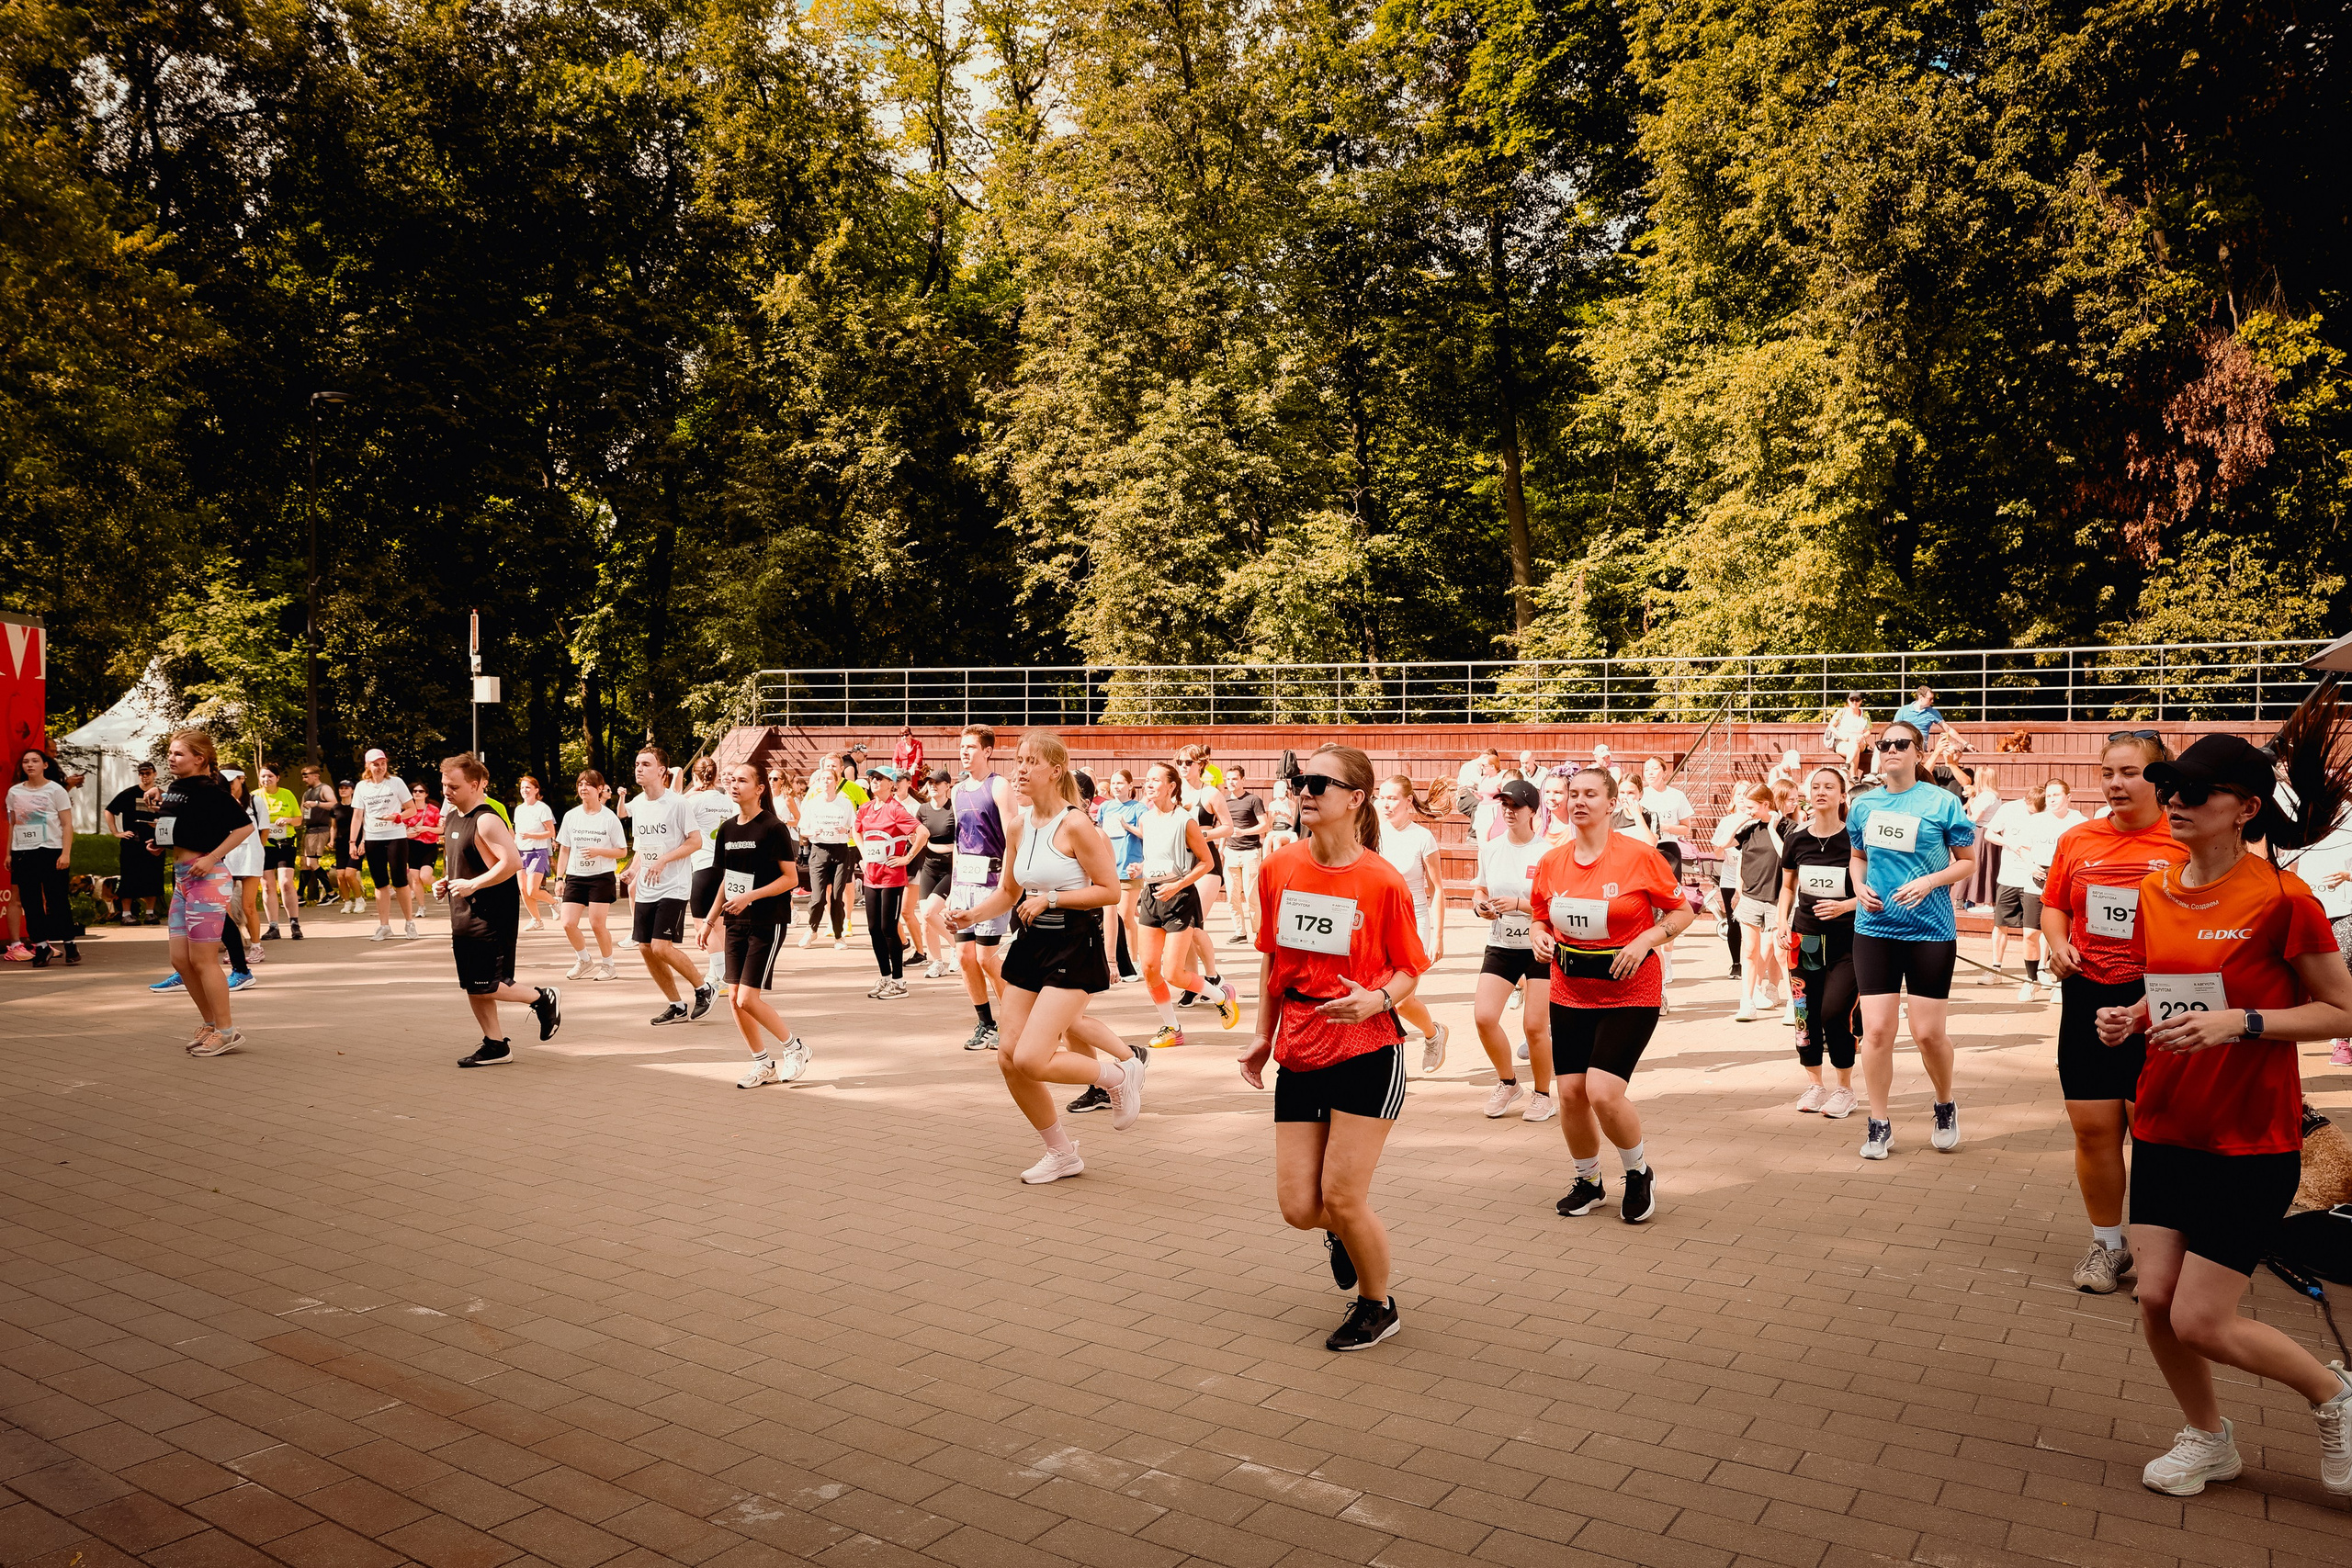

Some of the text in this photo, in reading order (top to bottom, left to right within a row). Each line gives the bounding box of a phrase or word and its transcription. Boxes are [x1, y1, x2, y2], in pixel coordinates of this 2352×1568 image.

[159, 828, 168, 836] 174
[638, 823, 667, 835] OLIN'S
[1878, 825, 1905, 839] 165
[725, 840, 756, 851] LLEYBALL
[643, 852, 658, 861] 102
[963, 866, 981, 874] 220
[1149, 870, 1167, 878] 221
[728, 882, 746, 894] 233
[1809, 878, 1834, 888] 212
[2190, 899, 2220, 910] Создаем
[2103, 906, 2136, 923] 197
[1295, 914, 1333, 935] 178
[1566, 915, 1589, 928] 111
[1506, 927, 1530, 937] 244
[2214, 928, 2253, 940] DKC
